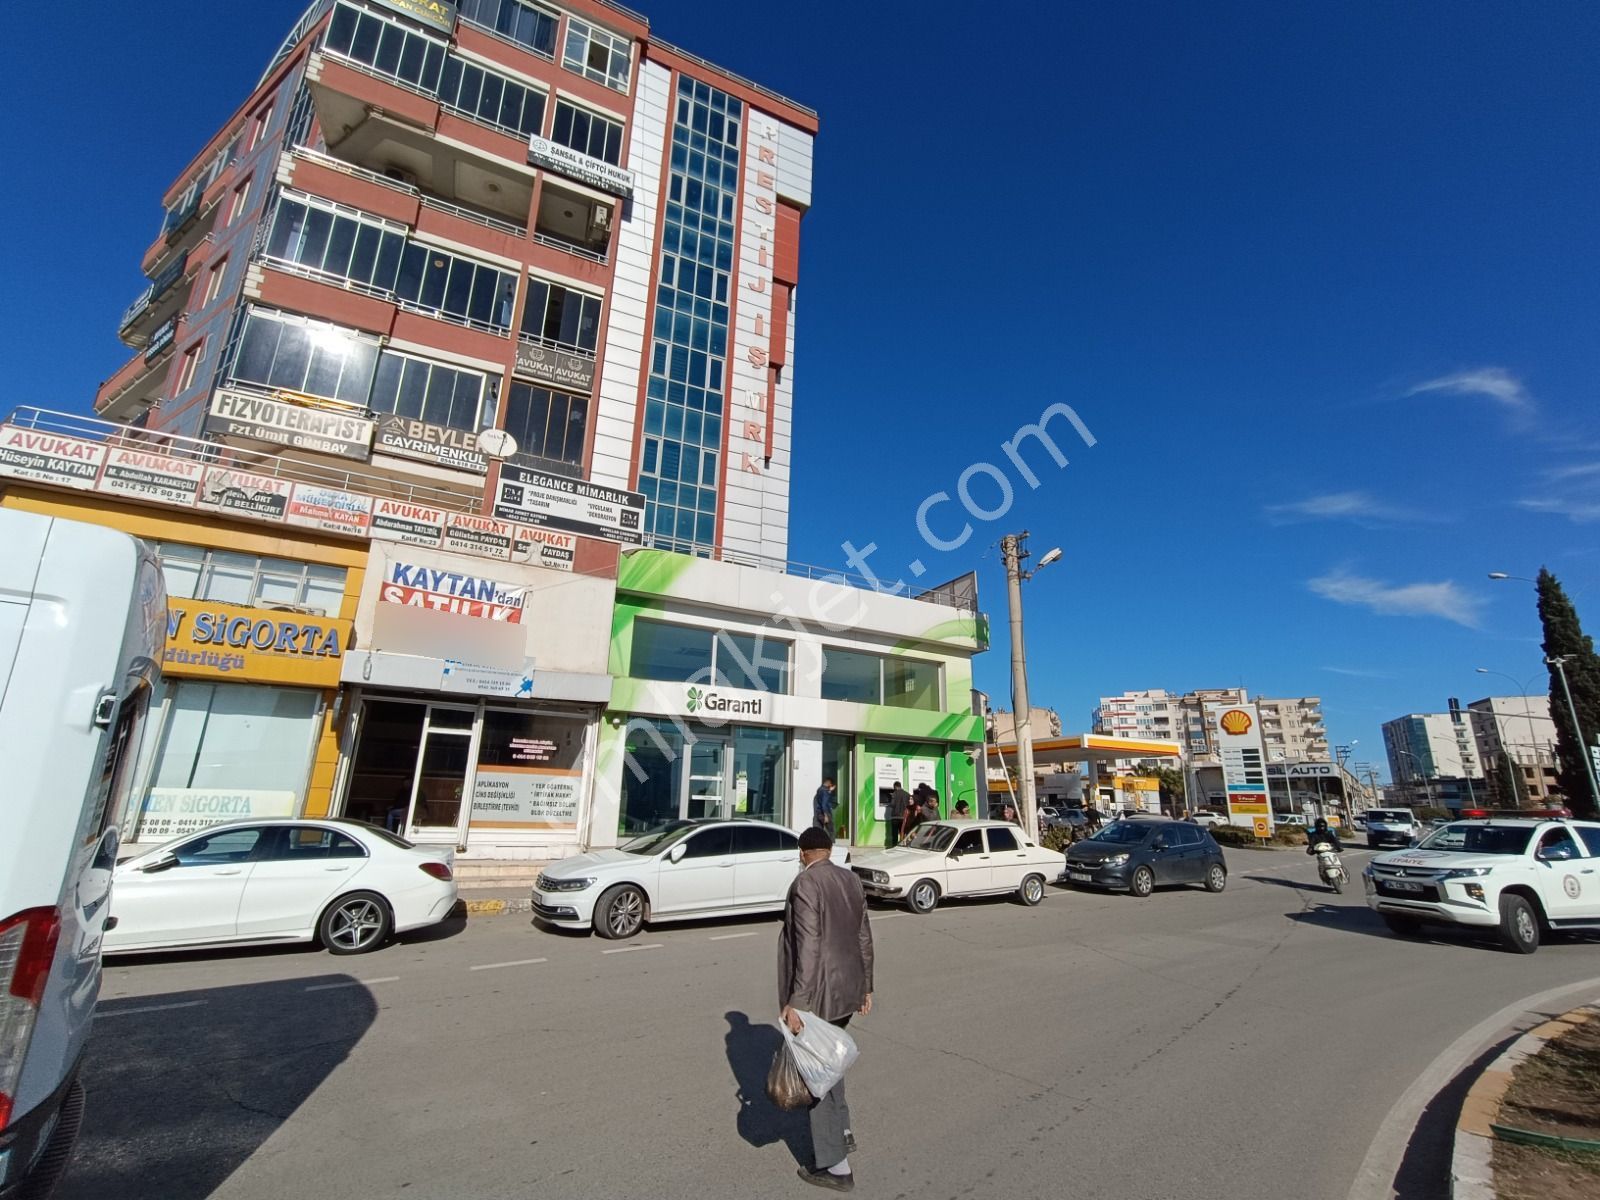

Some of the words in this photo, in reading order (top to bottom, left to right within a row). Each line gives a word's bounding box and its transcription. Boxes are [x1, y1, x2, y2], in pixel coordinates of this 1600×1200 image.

[550, 146, 577, 163] ŞANSAL
[579, 157, 584, 166] &
[585, 160, 607, 175] ÇİFTÇİ
[607, 168, 631, 183] HUKUK
[517, 357, 555, 373] AVUKAT
[556, 367, 592, 382] AVUKAT
[7, 432, 98, 460] AVUKAT
[0, 448, 45, 468] Hüseyin
[47, 458, 97, 477] KAYTAN
[117, 451, 197, 476] AVUKAT
[119, 469, 152, 482] Abdullah
[111, 480, 136, 491] 0414
[519, 472, 574, 493] ELEGANCE
[576, 482, 630, 506] MİMARLIK
[334, 511, 360, 523] KAYAN
[379, 502, 441, 523] AVUKAT
[452, 515, 509, 535] AVUKAT
[450, 539, 468, 549] 0414
[519, 529, 572, 548] AVUKAT
[543, 547, 570, 559] PAYDAŞ
[383, 585, 514, 621] SATILIK
[165, 647, 245, 672] dürlüğü
[1291, 766, 1331, 775] AUTO
